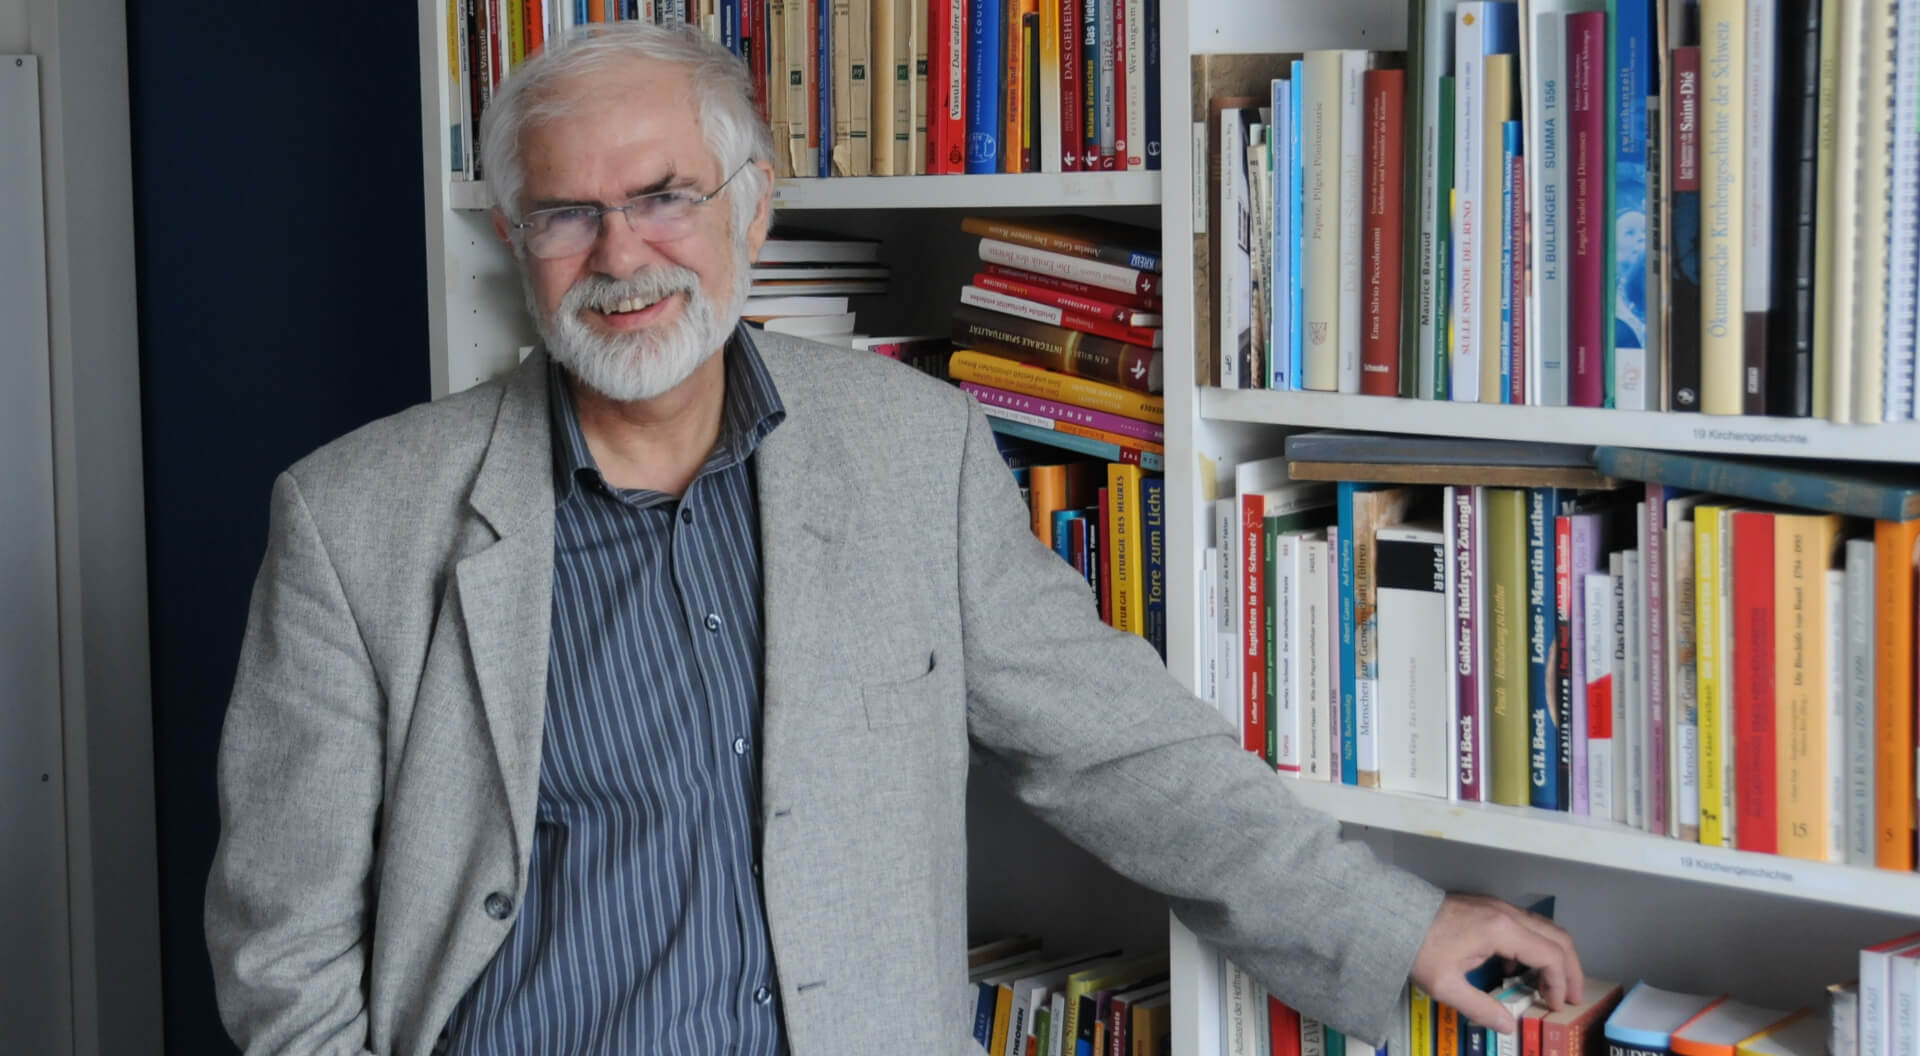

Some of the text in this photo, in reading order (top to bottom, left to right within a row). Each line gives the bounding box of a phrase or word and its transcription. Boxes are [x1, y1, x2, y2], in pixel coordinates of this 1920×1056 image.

[950, 14, 960, 45] wahre
[1084, 24, 1095, 45] Das
[1128, 6, 1141, 50] langsam
[950, 50, 960, 68] Das
[1064, 52, 1073, 80] DAS
[1101, 38, 1113, 73] Taizé
[1129, 53, 1139, 73] Wer
[951, 79, 960, 117] Vassula
[1086, 58, 1095, 105] Brantschen
[1678, 70, 1696, 131] Saint-Dié
[1086, 108, 1095, 138] Niklaus
[1576, 131, 1588, 176] Dämonen
[1311, 169, 1324, 201] Pilger,
[1543, 80, 1557, 280] H. BULLINGER SUMMA 1556
[1576, 178, 1587, 197] und
[1706, 21, 1735, 338] Ökumenische Kirchengeschichte der Schweiz
[1130, 253, 1155, 270] KREUZ
[1422, 231, 1432, 275] Bavaud
[1370, 227, 1382, 339] Enea Silvio Piccolomini
[1460, 199, 1473, 356] SULLE SPONDE DEL RENO
[1421, 277, 1432, 326] Maurice
[968, 323, 1063, 355] INTEGRALE SPIRITUALITÄT
[1094, 353, 1109, 365] KEN
[1038, 404, 1093, 422] MENSCH
[1693, 428, 1809, 444] 19 Kirchengeschichte
[1147, 486, 1161, 525] Licht
[1456, 495, 1471, 550] Zwingli
[1530, 492, 1544, 547] Luther
[1115, 475, 1128, 633] LITURGIE LITURGIE DES HEURES
[1150, 530, 1161, 565] zum
[1433, 547, 1444, 591] PIPER
[1457, 550, 1472, 619] Huldrych
[1531, 548, 1544, 605] Martin
[1614, 575, 1624, 597] Dei
[1149, 570, 1161, 605] Tore
[1247, 532, 1259, 656] Baptisten in der Schweiz
[1494, 583, 1505, 614] Luther
[1614, 599, 1625, 635] Opus
[1356, 543, 1370, 736] Menschen zur Gemeinschaft führen
[1459, 626, 1471, 675] Gäbler
[1532, 615, 1545, 664] Lohse
[1614, 637, 1624, 661] Das
[1344, 693, 1353, 738] Buchverlag
[1682, 704, 1694, 722] zur
[1680, 727, 1696, 787] Menschen
[1703, 759, 1713, 790] Ursula
[1793, 823, 1807, 837] 15
[1680, 856, 1794, 882] 19 Kirchengeschichte
[1231, 968, 1242, 1001] Hoffnu
[1233, 1002, 1242, 1017] der
